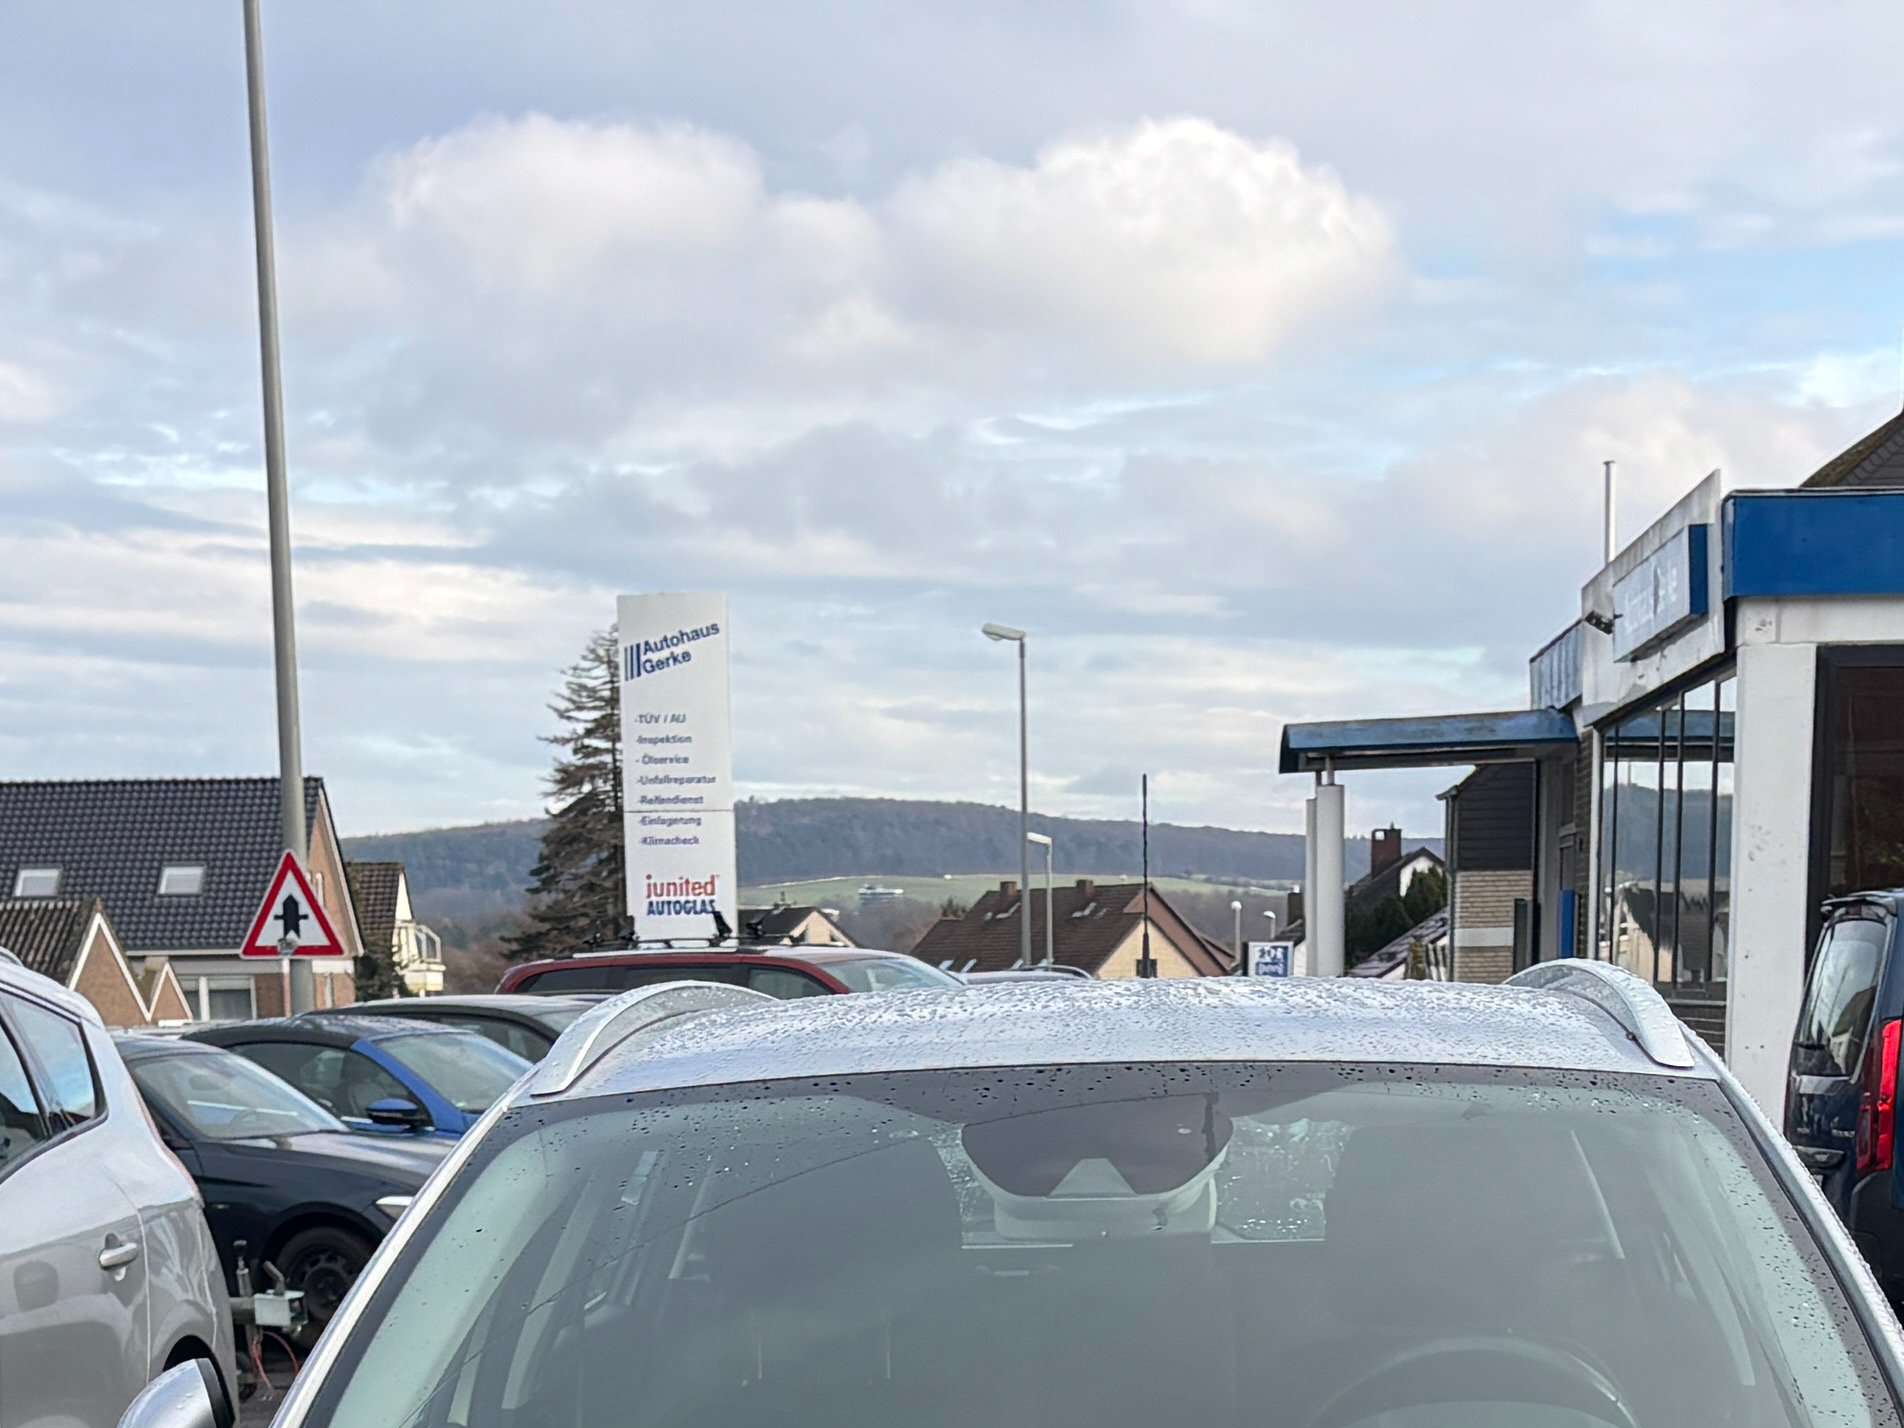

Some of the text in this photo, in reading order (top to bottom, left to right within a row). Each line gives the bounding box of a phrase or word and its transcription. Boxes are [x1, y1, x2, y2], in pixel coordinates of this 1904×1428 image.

[643, 623, 720, 655] Autohaus
[643, 651, 691, 674] Gerke
[645, 874, 716, 899] junited
[646, 899, 716, 916] AUTOGLAS
